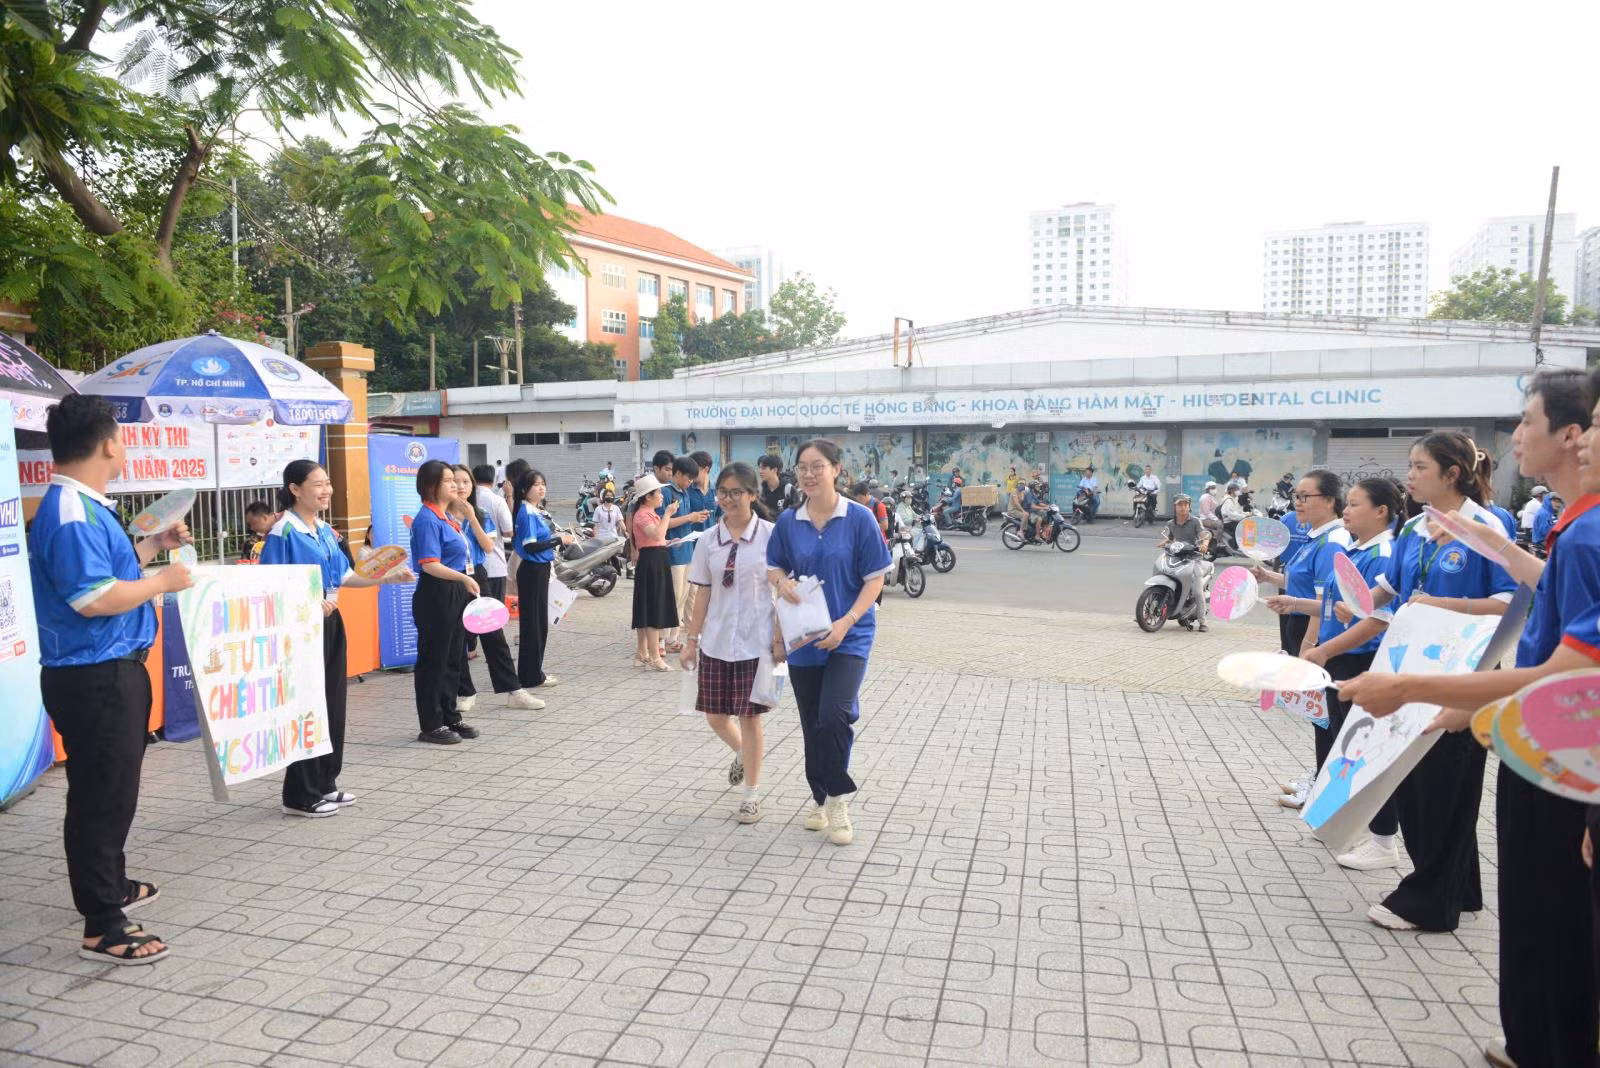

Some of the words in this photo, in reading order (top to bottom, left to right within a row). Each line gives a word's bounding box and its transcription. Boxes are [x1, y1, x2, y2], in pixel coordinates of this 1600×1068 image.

[176, 378, 189, 386] TP.
[221, 380, 245, 388] MINH
[686, 405, 737, 419] TRƯỜNG
[740, 405, 763, 420] ĐẠI
[766, 404, 795, 420] HỌC
[971, 398, 1018, 411] KHOA
[1077, 391, 1118, 410] HÀM
[1223, 391, 1304, 407] DENTAL
[1310, 388, 1382, 405] CLINIC
[141, 422, 160, 447] KỲ
[164, 426, 188, 447] THI
[132, 454, 168, 480] NĂM
[171, 458, 206, 479] 2025
